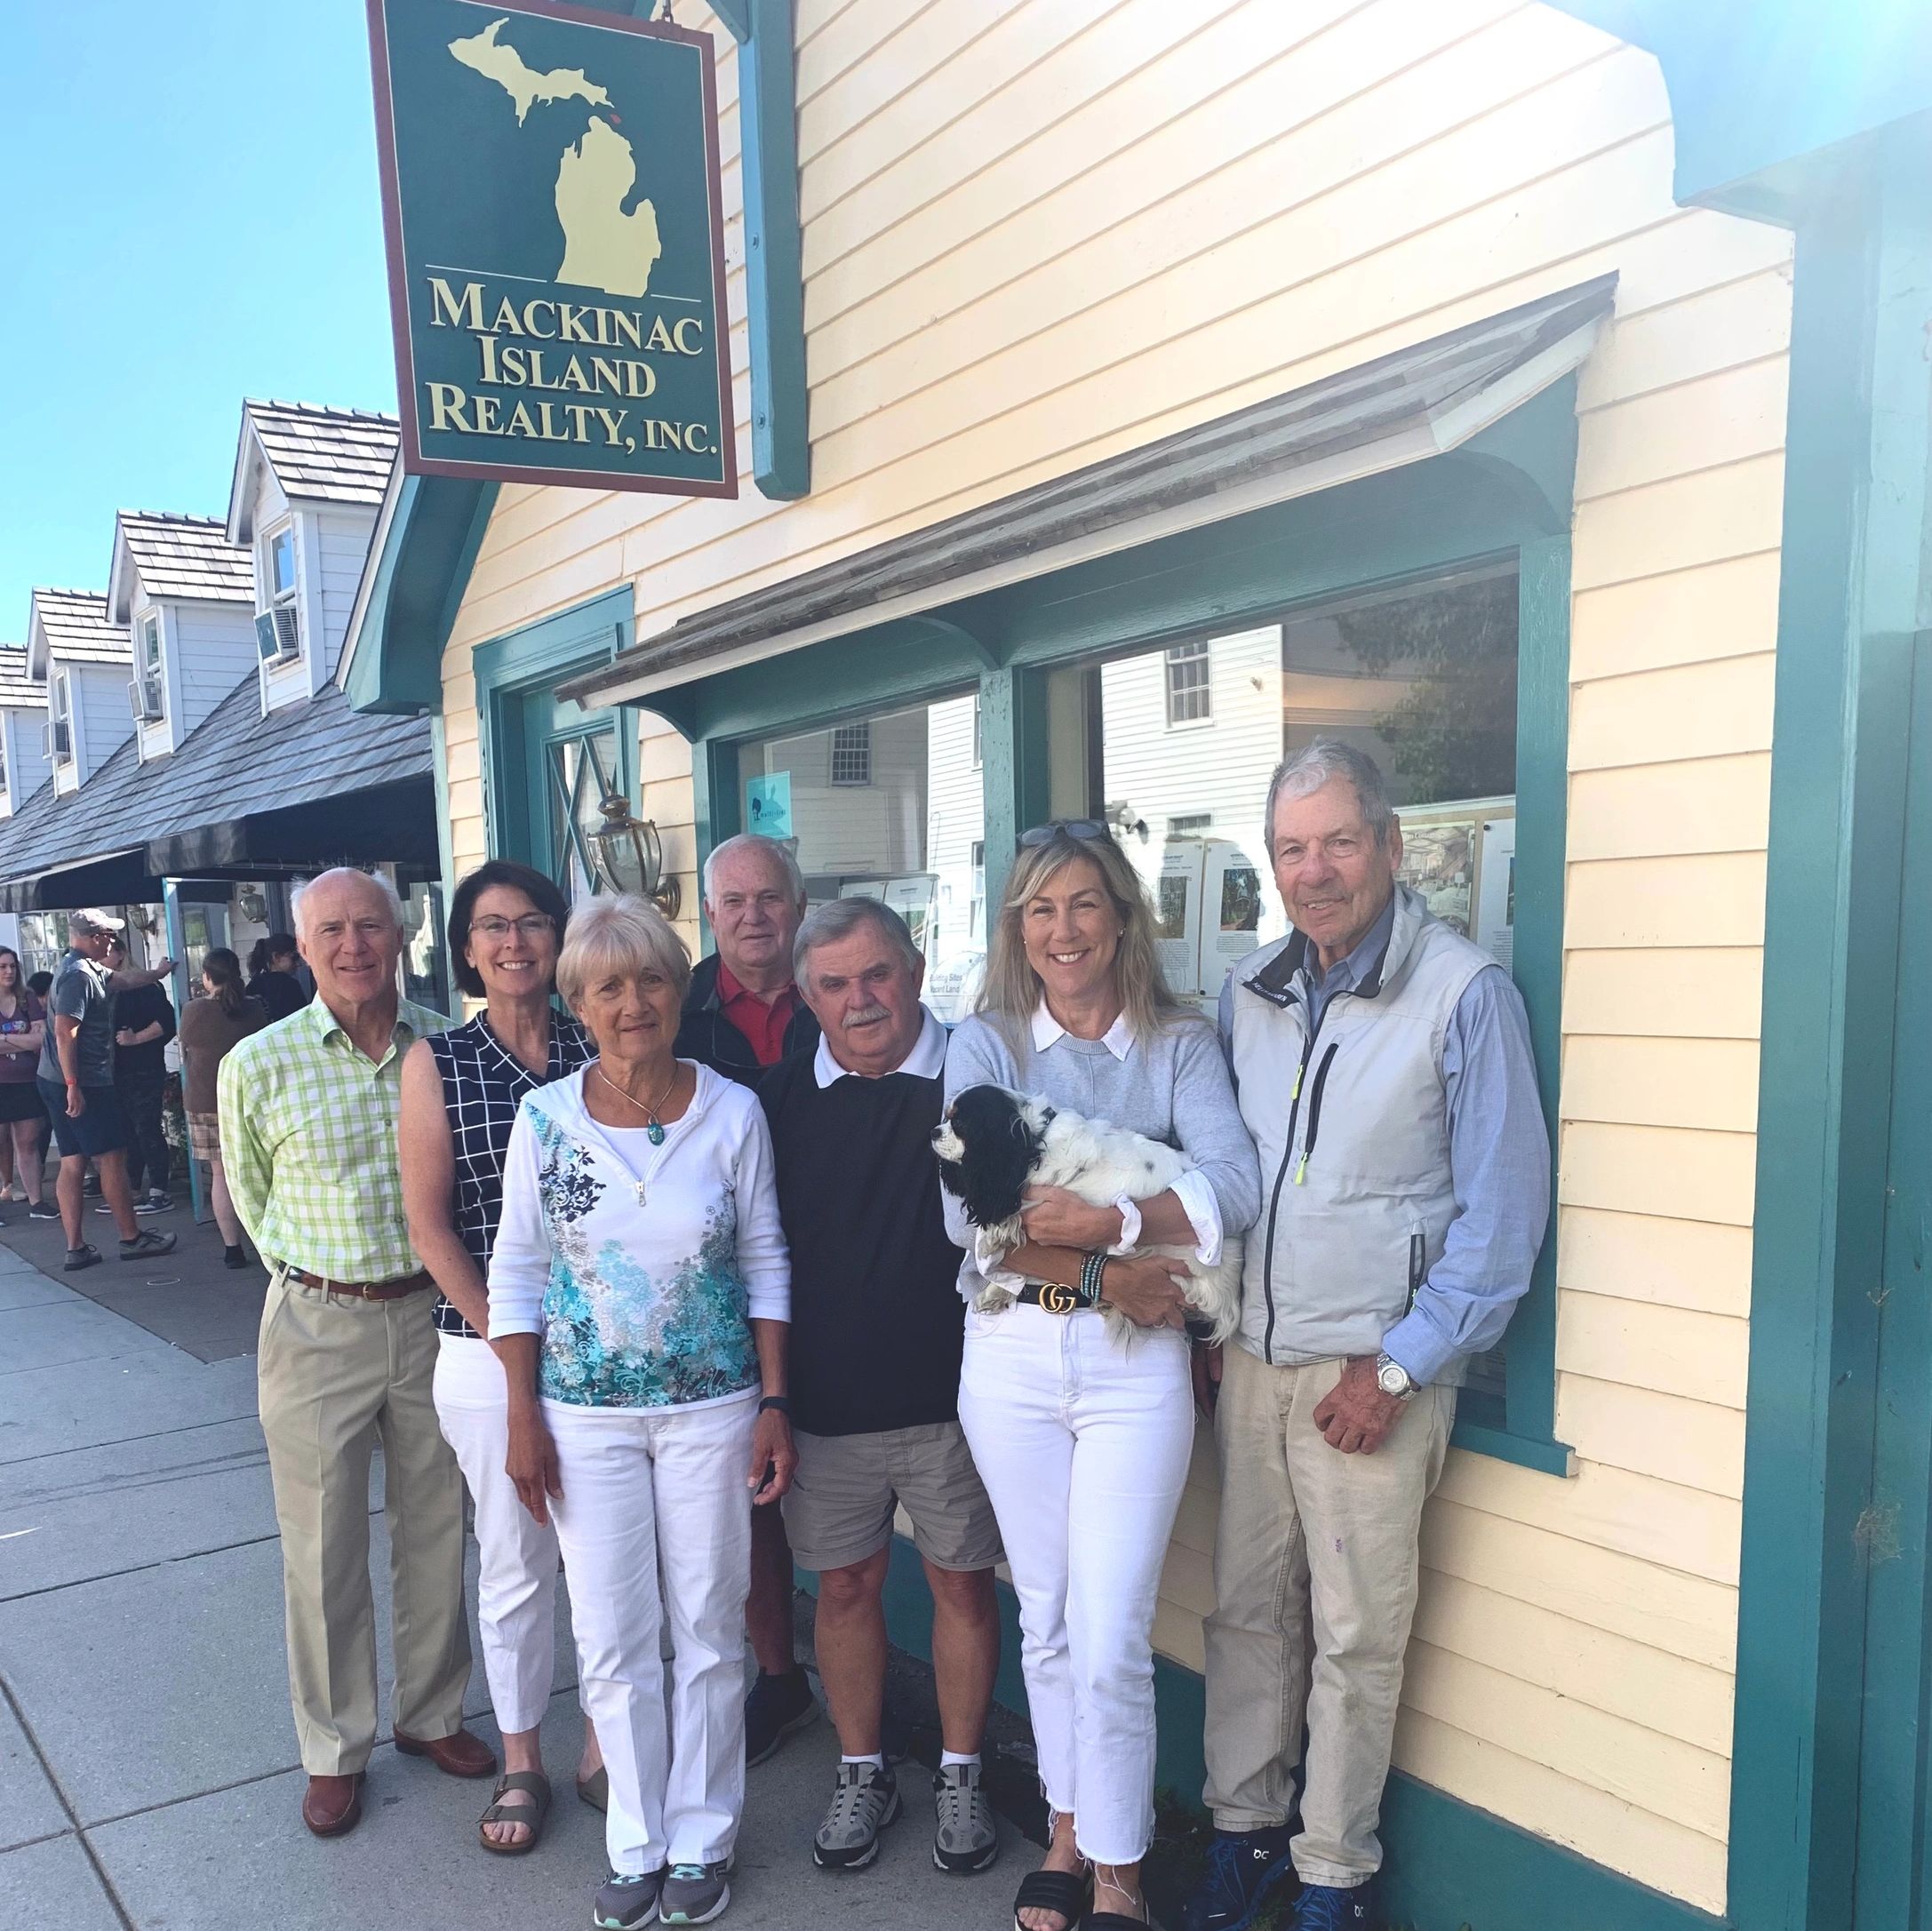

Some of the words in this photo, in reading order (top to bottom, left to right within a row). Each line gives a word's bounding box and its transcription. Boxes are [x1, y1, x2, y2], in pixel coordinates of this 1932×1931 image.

[426, 276, 704, 356] MACKINAC
[476, 334, 658, 399] ISLAND
[425, 382, 636, 456] REALTY,
[643, 419, 719, 455] INC.
